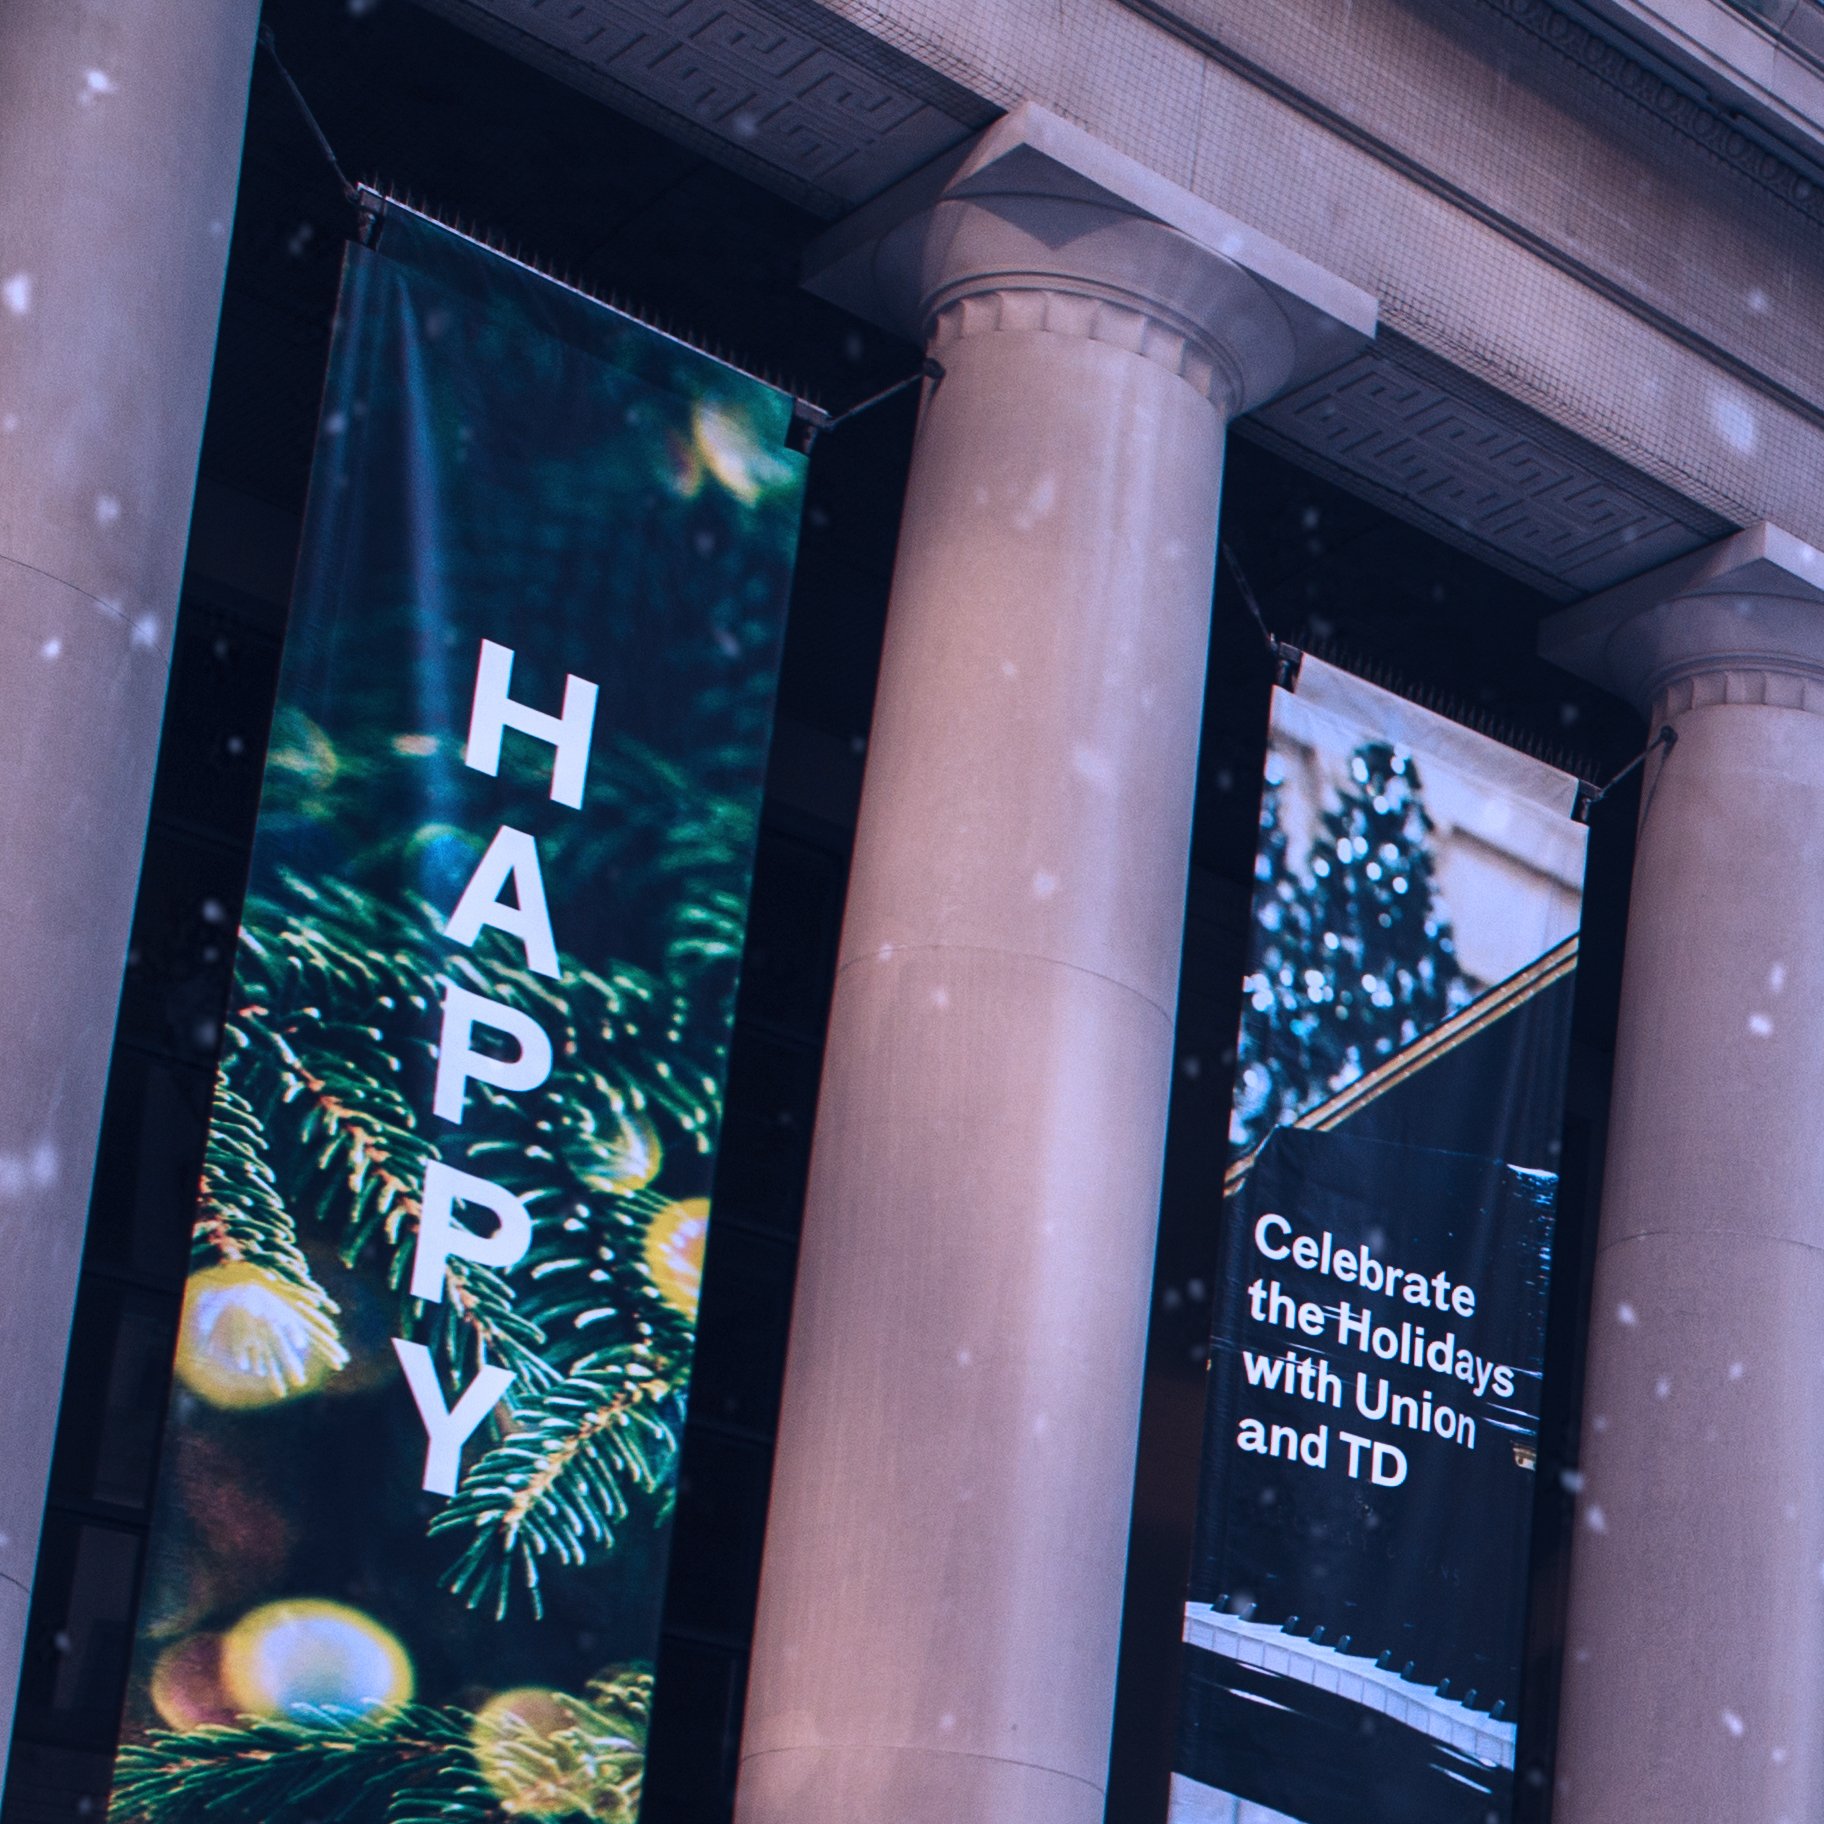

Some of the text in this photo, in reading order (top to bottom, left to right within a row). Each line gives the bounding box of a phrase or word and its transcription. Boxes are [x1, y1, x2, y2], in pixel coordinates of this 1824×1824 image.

[391, 638, 601, 1497] HAPPY
[1254, 1213, 1476, 1318] Celebrate
[1247, 1278, 1516, 1398] the Holidays
[1236, 1417, 1408, 1488] and TD
[1242, 1350, 1476, 1450] with Union
